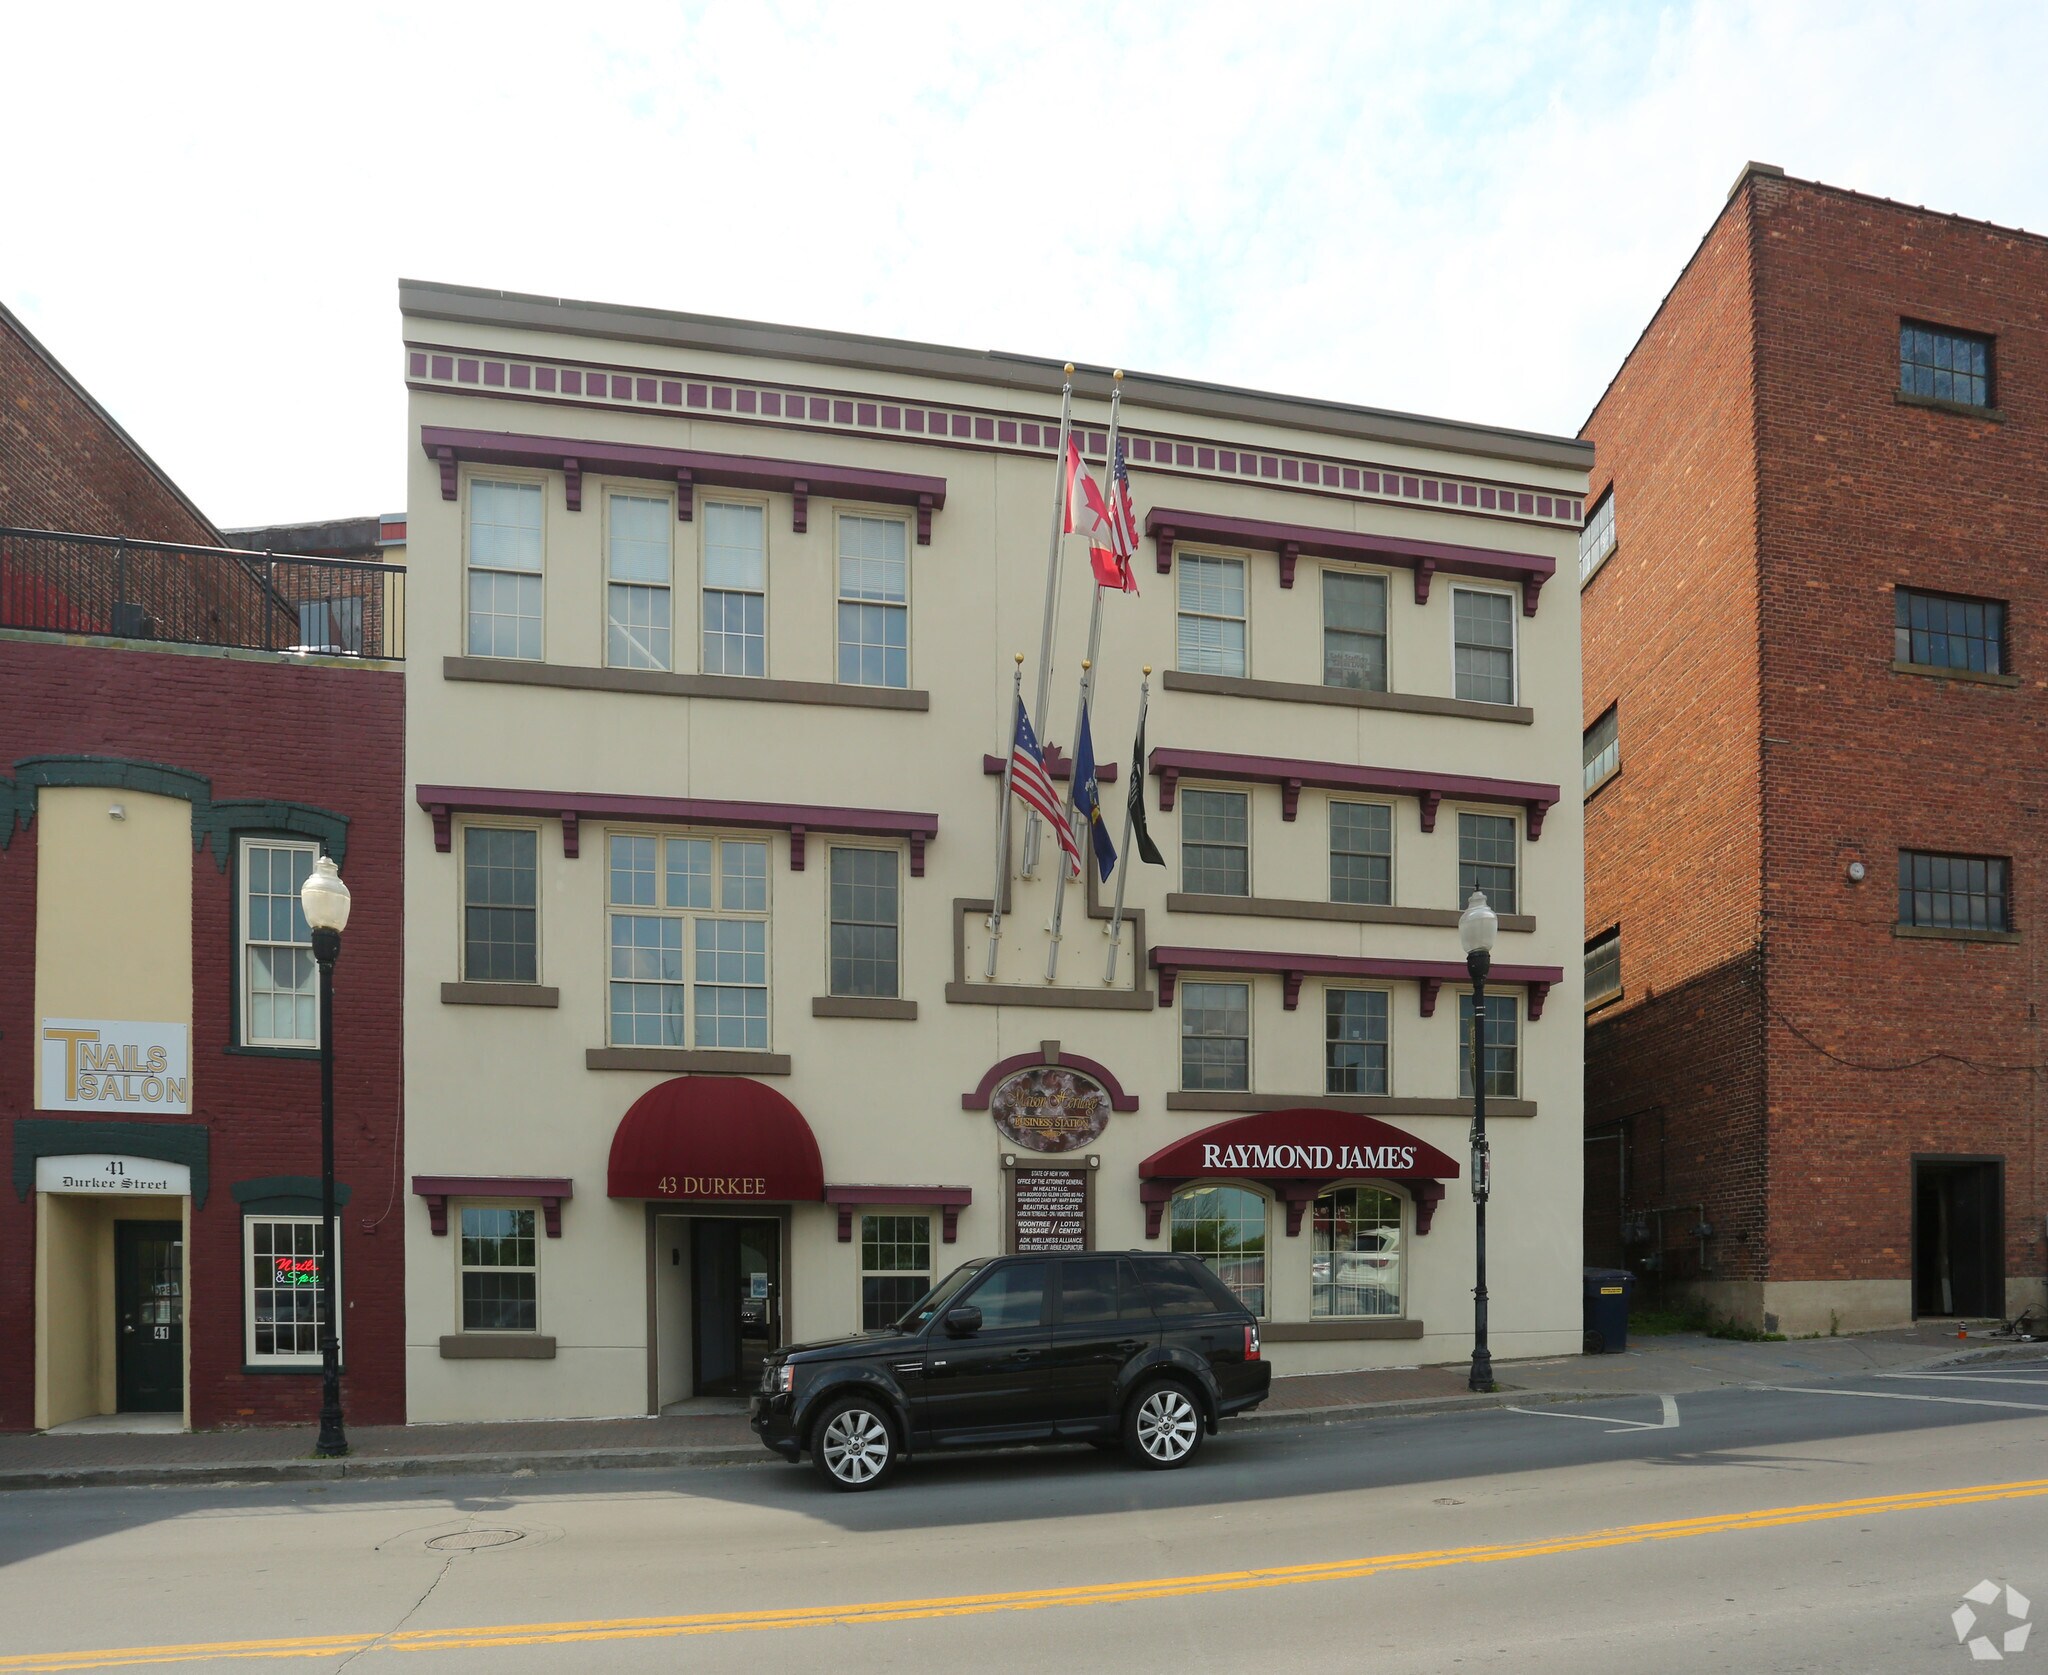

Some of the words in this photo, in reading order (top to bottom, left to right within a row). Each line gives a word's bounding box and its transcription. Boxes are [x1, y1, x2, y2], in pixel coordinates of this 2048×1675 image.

[79, 1074, 186, 1103] SALON
[1014, 1116, 1054, 1128] BUSINESS
[1054, 1116, 1090, 1129] STATION
[1202, 1144, 1333, 1170] RAYMOND
[105, 1161, 125, 1176] 41
[62, 1176, 116, 1188] Durkee
[120, 1177, 168, 1190] Street
[658, 1176, 677, 1194] 43
[683, 1176, 767, 1195] DURKEE
[284, 1271, 320, 1286] Spa
[155, 1327, 168, 1339] 41
